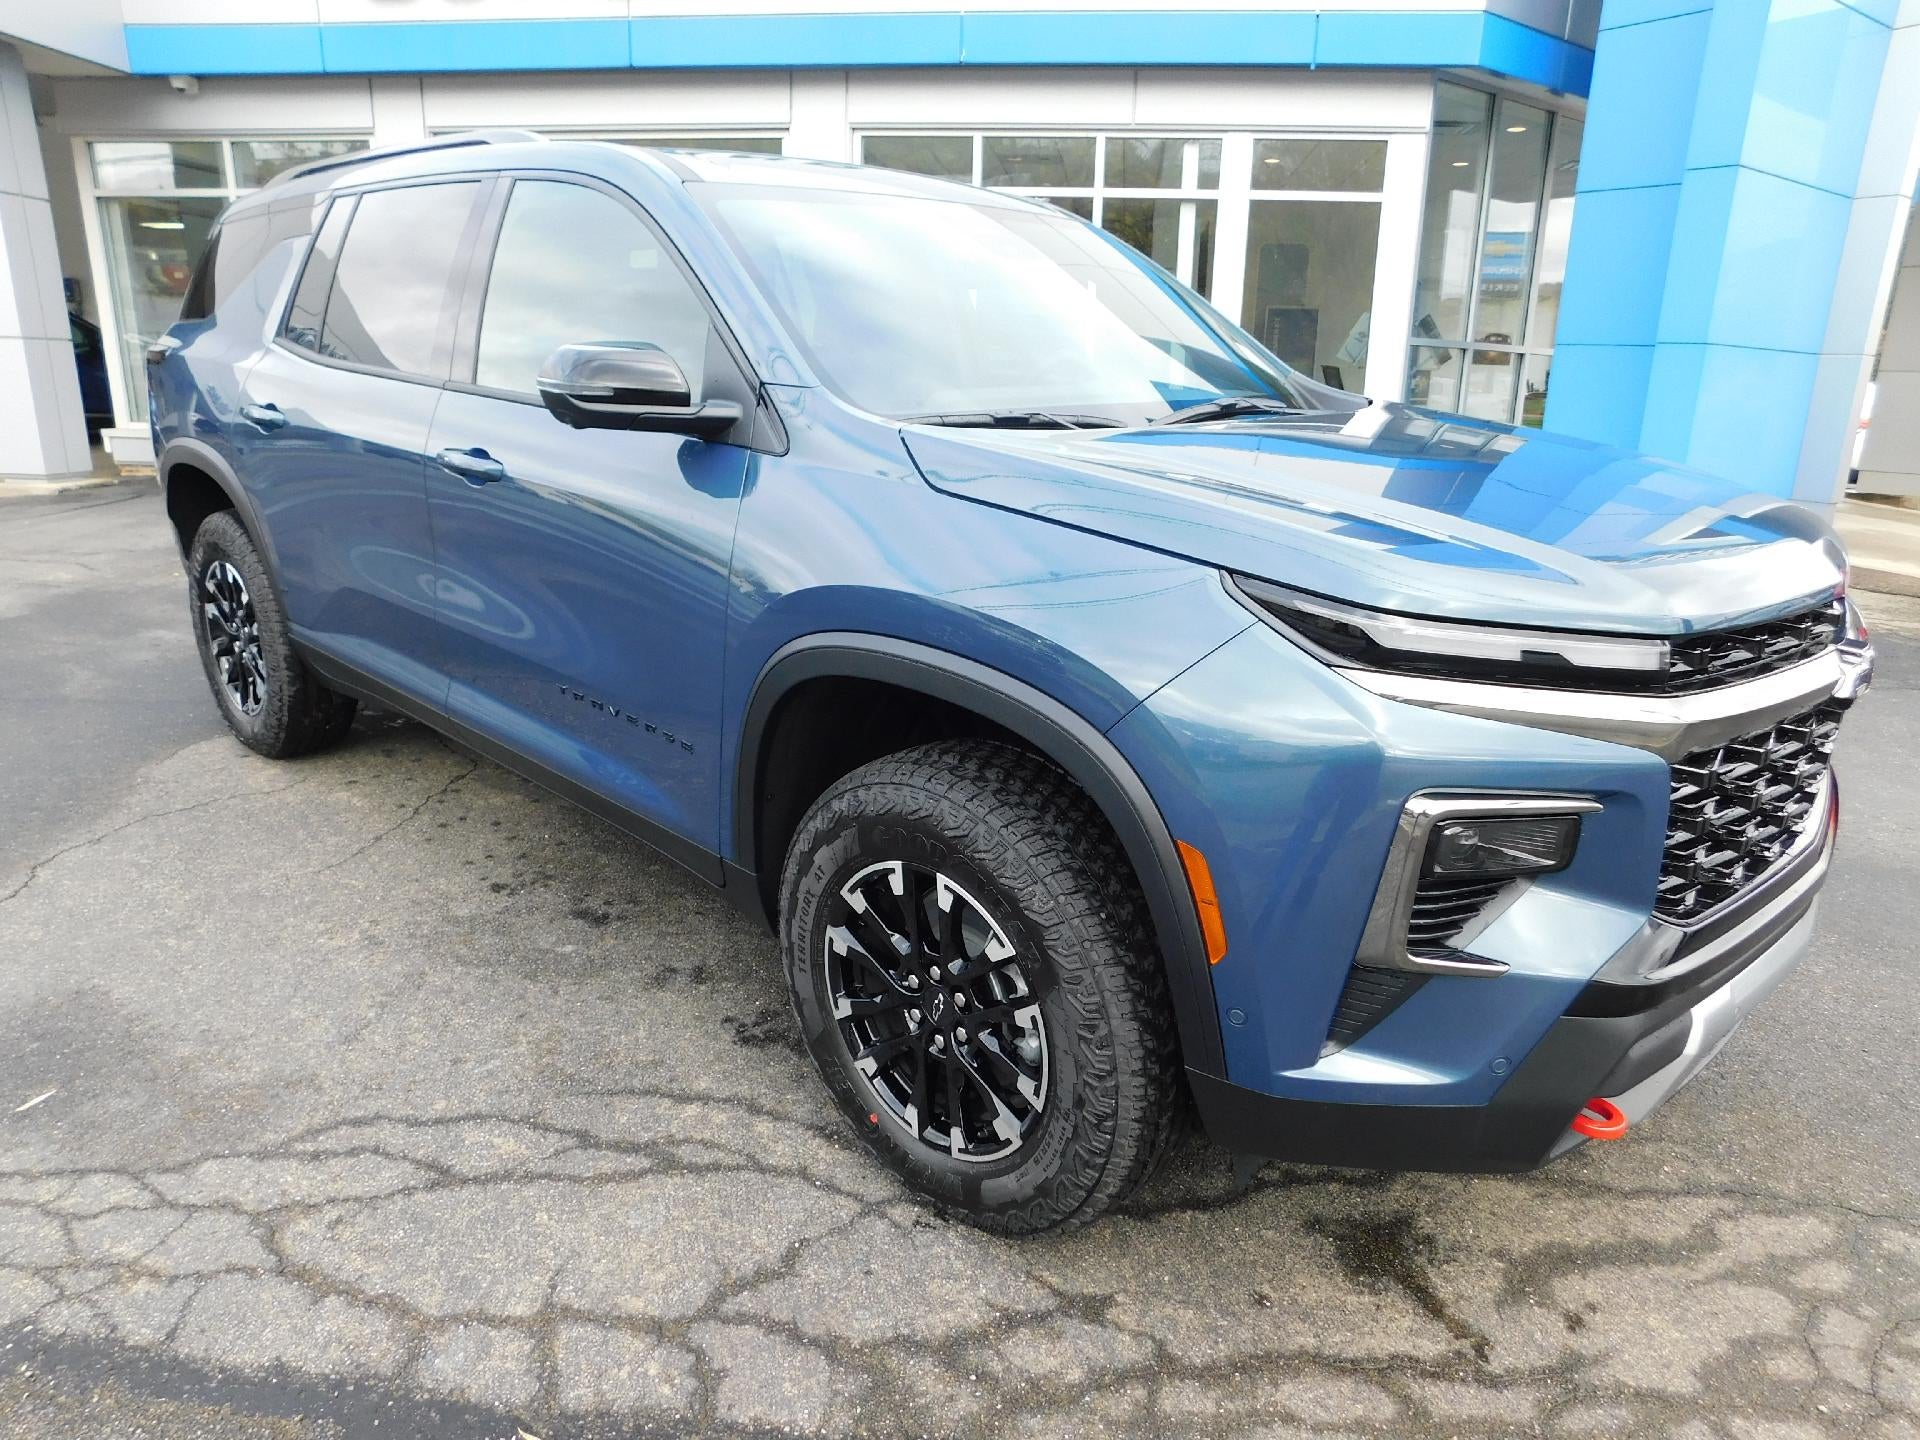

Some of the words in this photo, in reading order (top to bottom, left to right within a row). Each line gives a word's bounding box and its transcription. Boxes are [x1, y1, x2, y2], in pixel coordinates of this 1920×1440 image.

[555, 683, 695, 755] TRAVERSE
[798, 888, 815, 974] TERRITORY
[813, 864, 826, 884] AT
